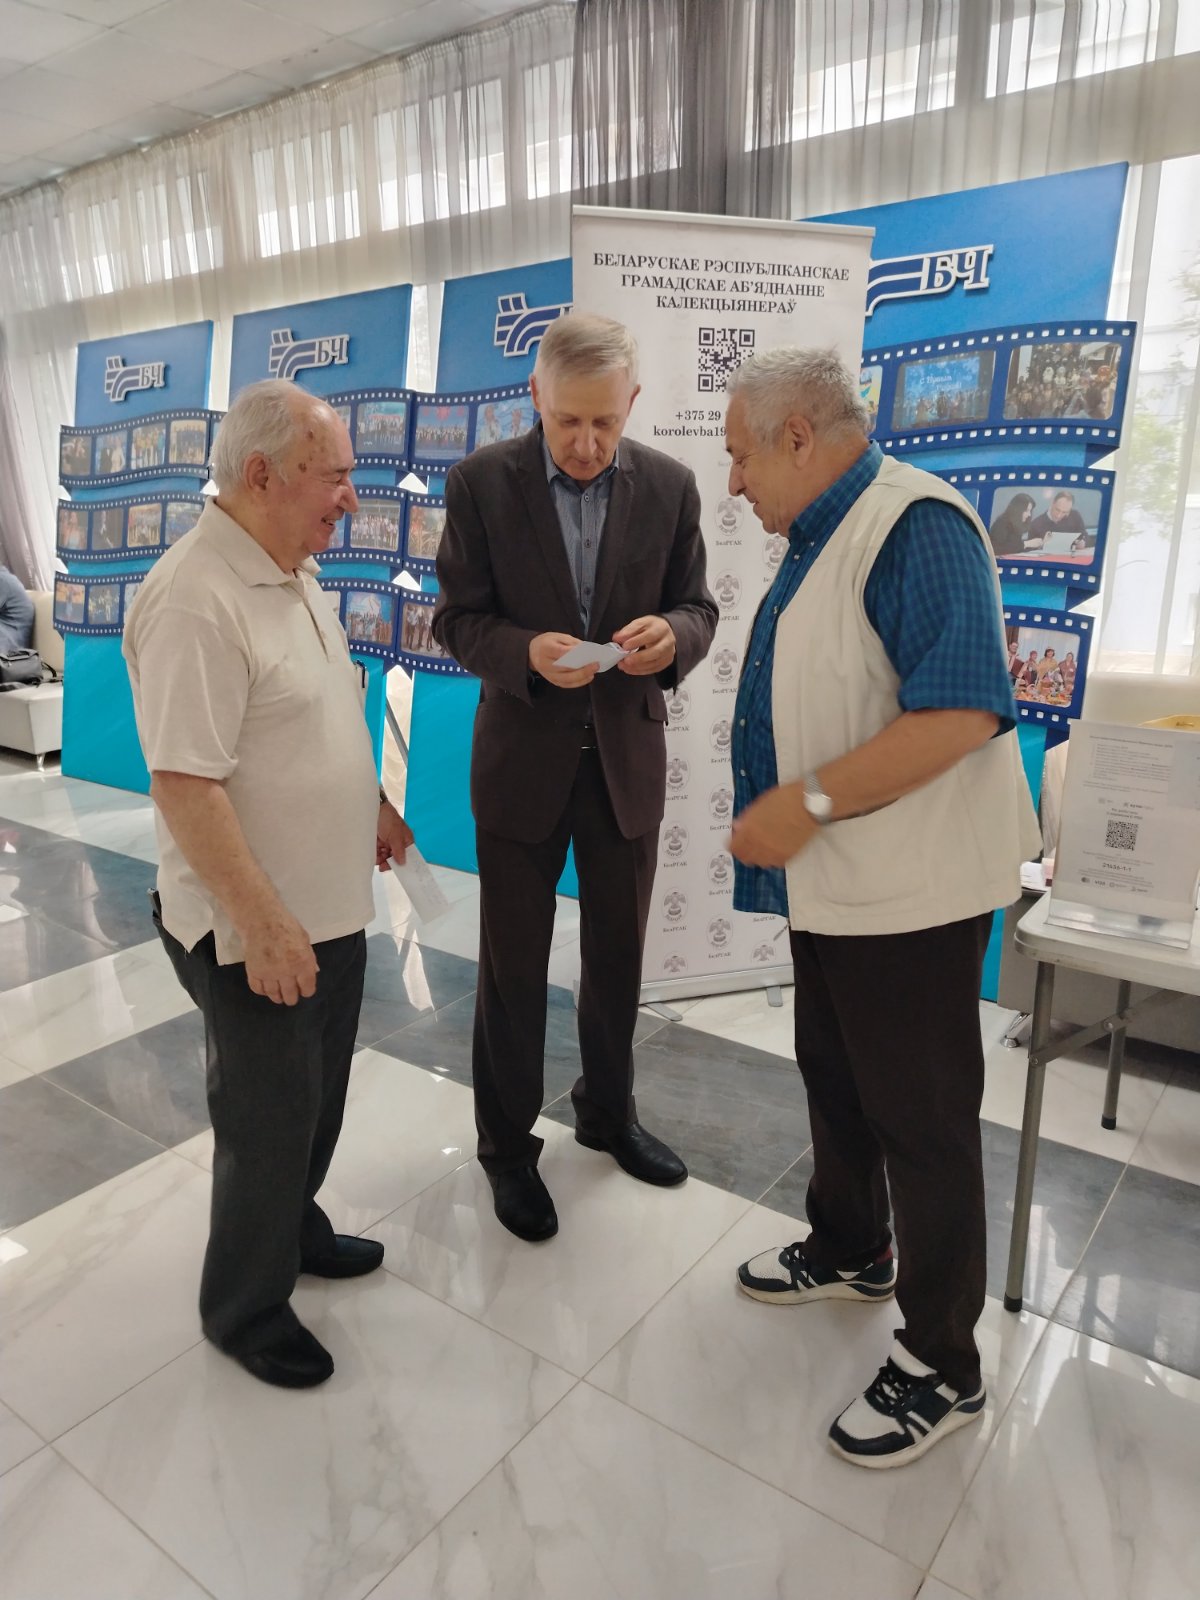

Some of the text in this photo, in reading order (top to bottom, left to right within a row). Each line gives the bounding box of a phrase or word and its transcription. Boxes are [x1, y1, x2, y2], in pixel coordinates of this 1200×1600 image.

[593, 252, 850, 281] БЕЛАРУСКАЕ РЭСПУБЛІКАНСКАЕ
[923, 246, 992, 290] БЧ
[621, 274, 726, 293] ГРАМАДСКАЕ
[656, 295, 797, 314] КАЛЕКЦЫЯНЕРАЎ
[317, 335, 349, 364] БЧ
[140, 362, 164, 388] БЧ
[675, 410, 722, 421] +375 29
